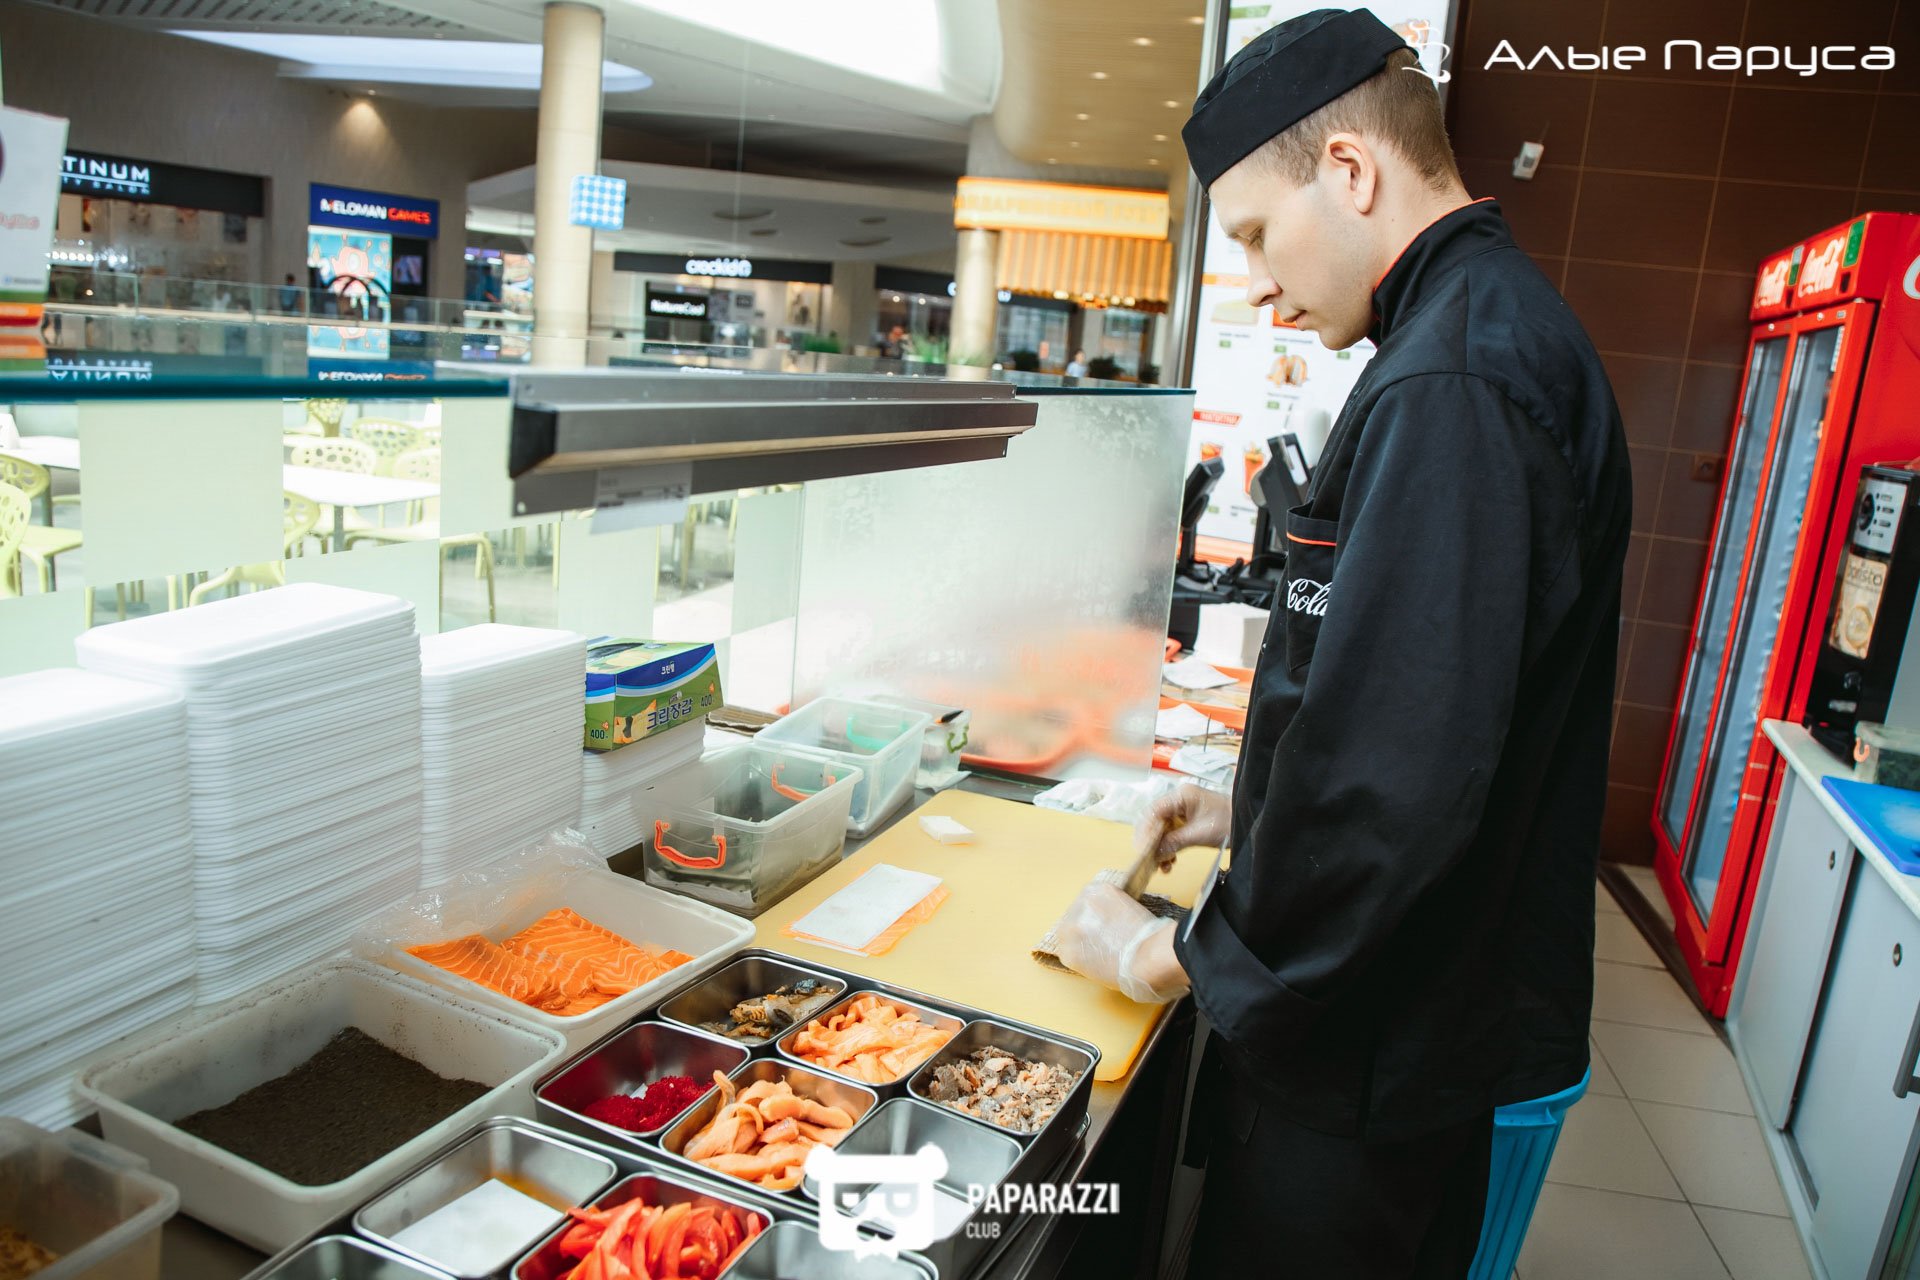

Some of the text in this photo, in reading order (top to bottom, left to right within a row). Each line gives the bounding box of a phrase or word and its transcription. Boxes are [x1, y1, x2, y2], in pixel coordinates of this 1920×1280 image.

[59, 155, 150, 183] TINUM
[320, 198, 431, 225] MELOMAN GAMES
[590, 729, 605, 740] 400
